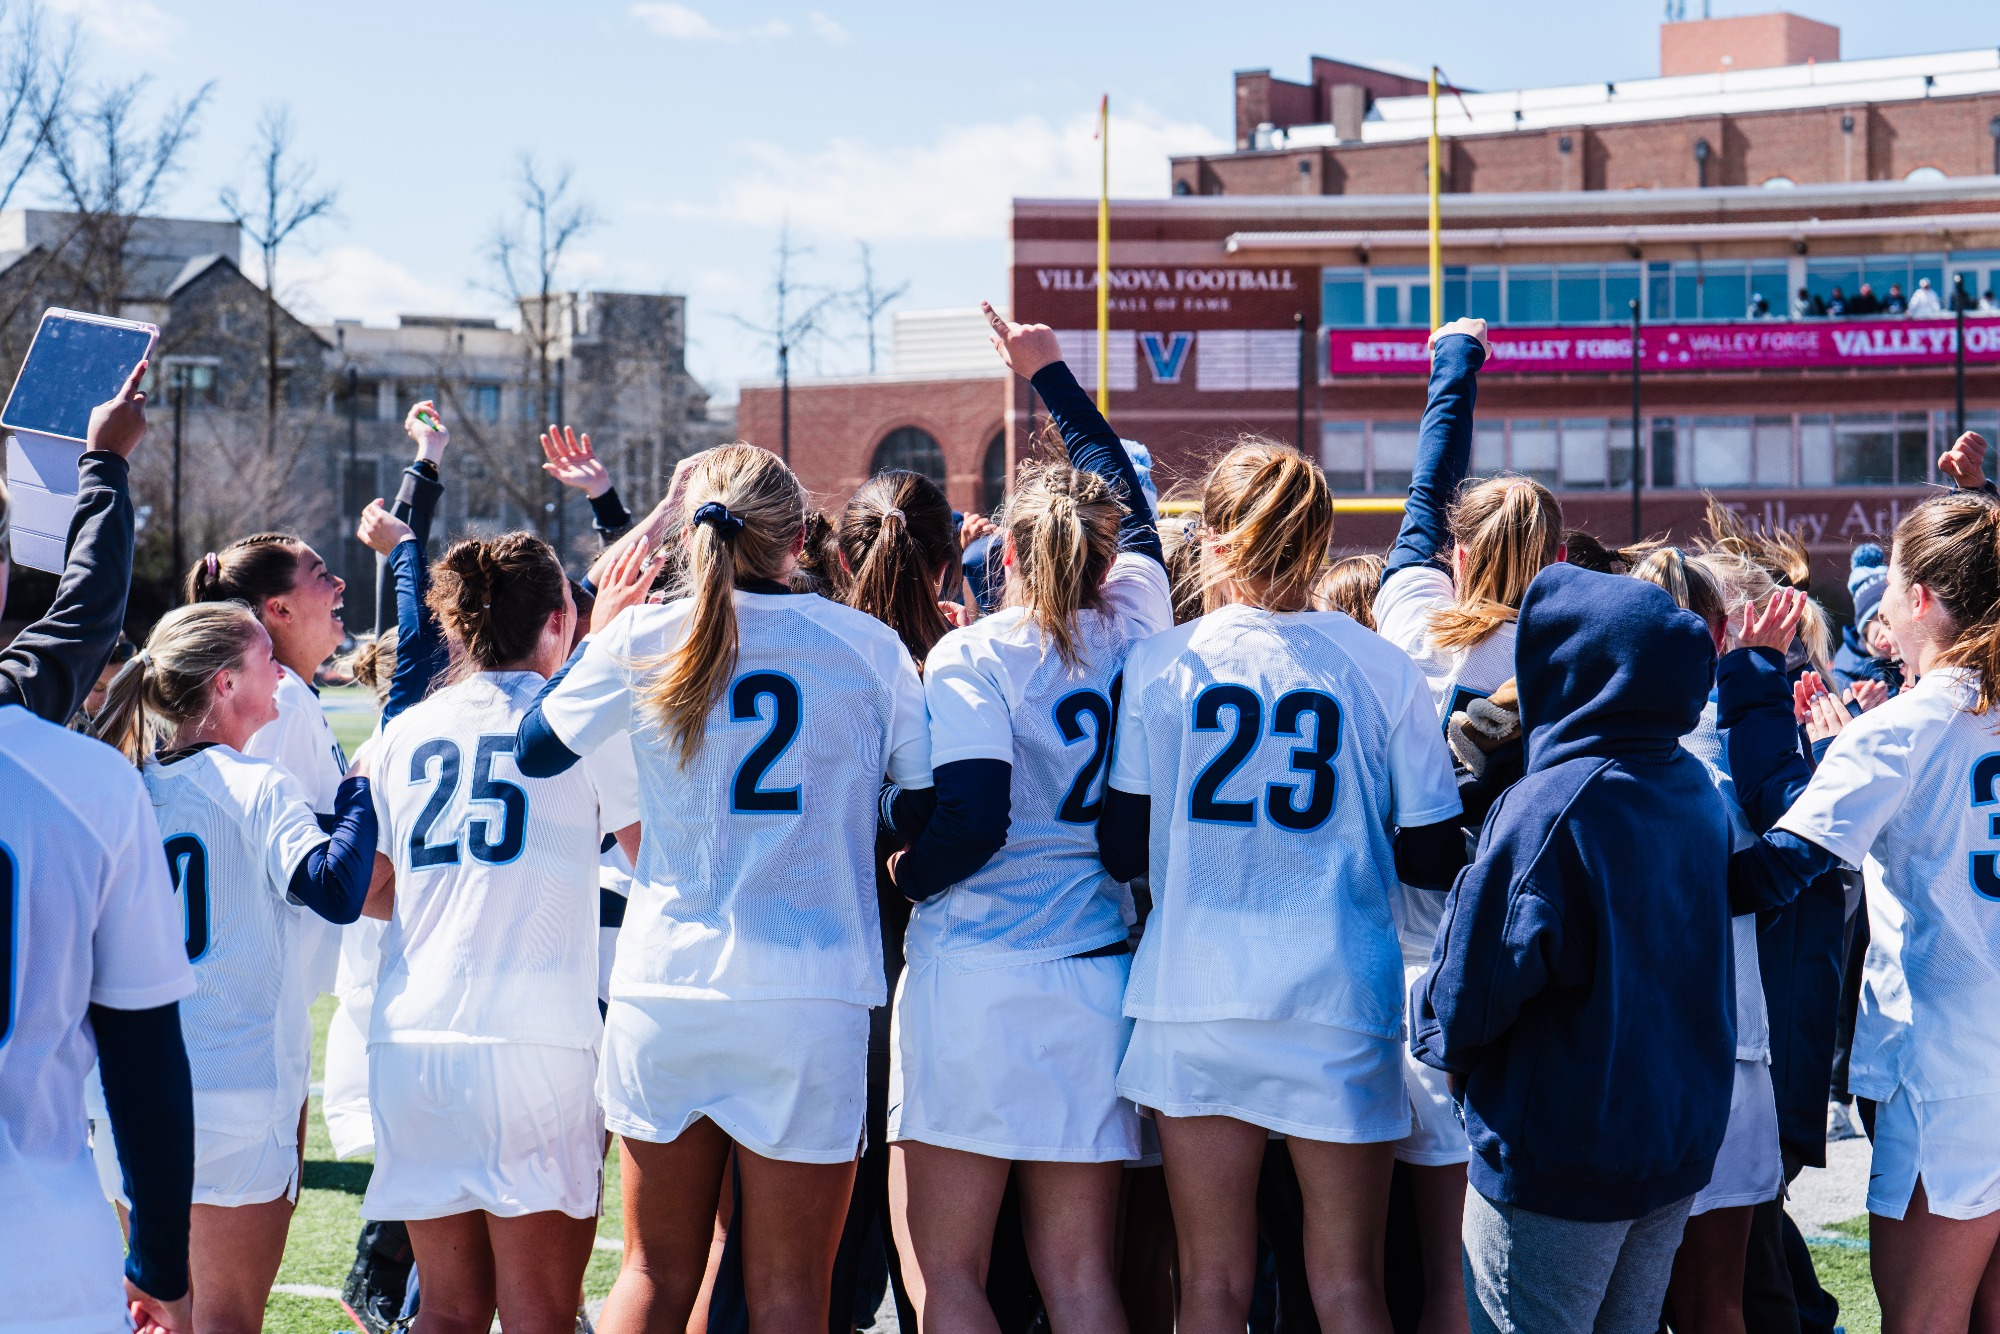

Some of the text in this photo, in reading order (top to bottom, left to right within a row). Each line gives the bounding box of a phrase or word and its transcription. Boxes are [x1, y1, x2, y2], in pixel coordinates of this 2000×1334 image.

[1175, 269, 1297, 291] FOOTBALL
[1492, 339, 1570, 360] VALLEY
[1688, 331, 1819, 352] VALLEY FORGE
[729, 669, 802, 815] 2
[1188, 683, 1341, 833] 23
[408, 733, 529, 871] 25
